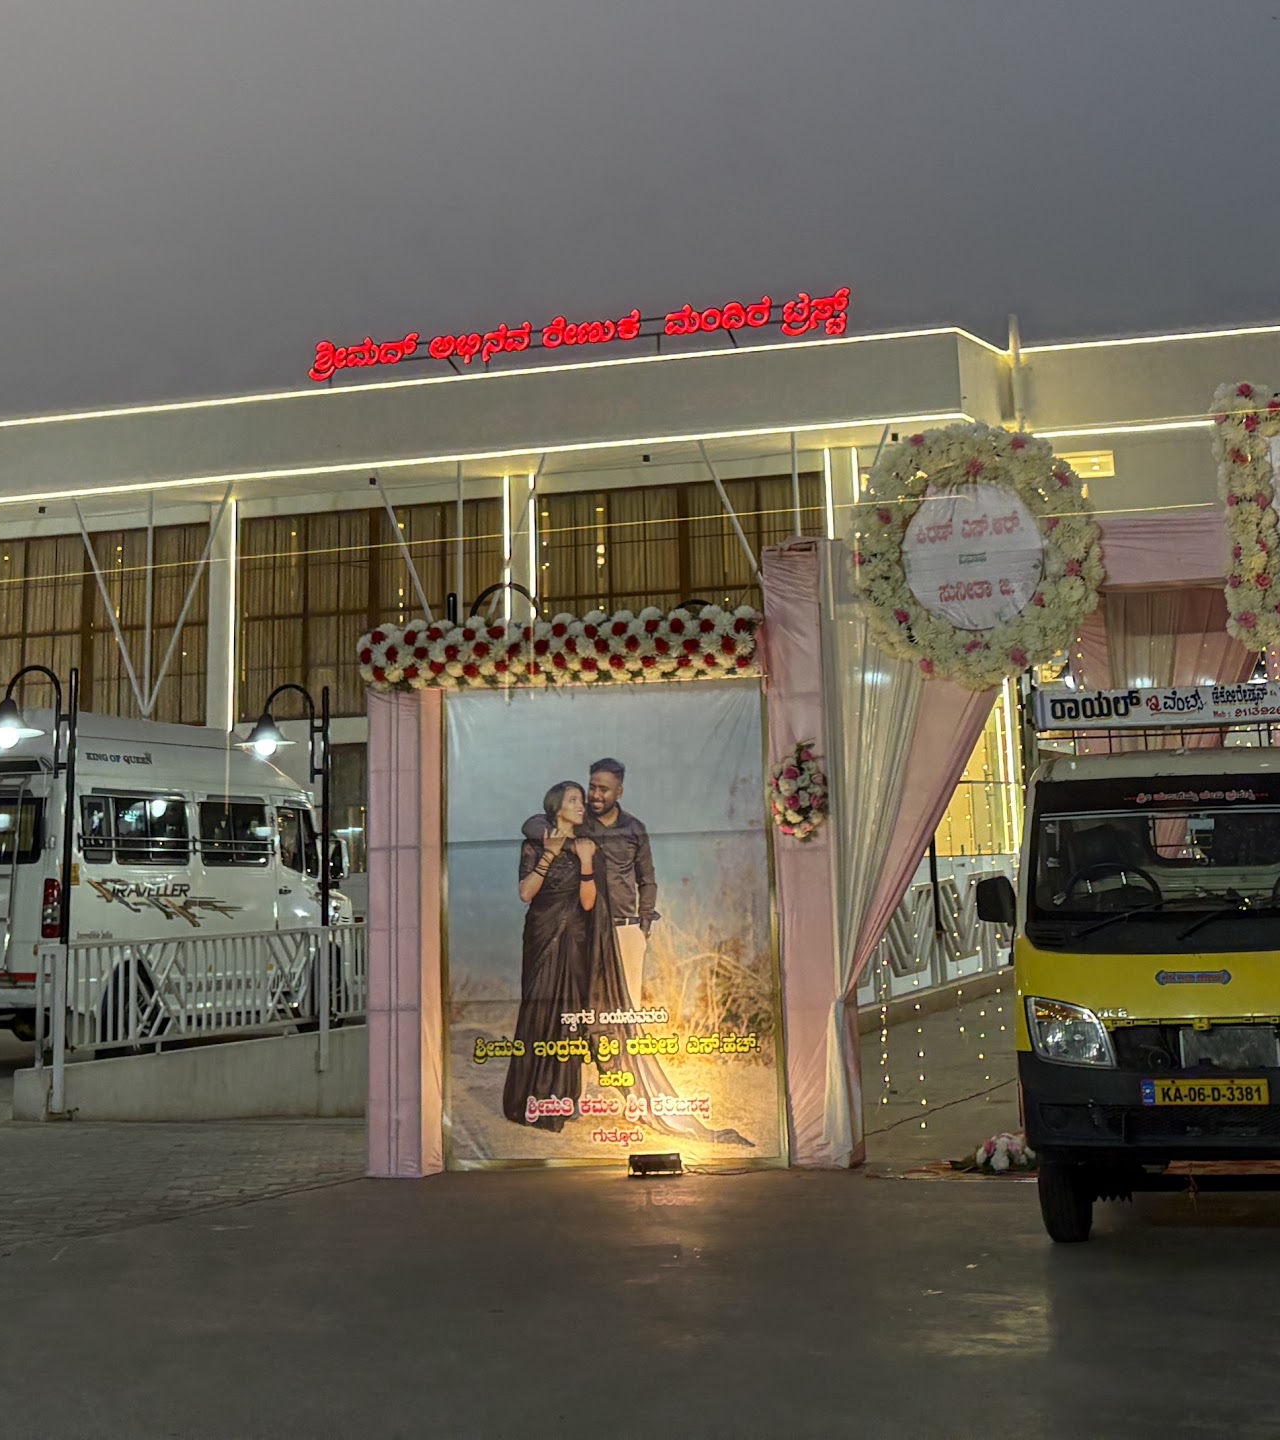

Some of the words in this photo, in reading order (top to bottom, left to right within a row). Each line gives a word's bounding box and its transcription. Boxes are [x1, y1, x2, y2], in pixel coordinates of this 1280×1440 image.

[308, 331, 419, 382] ಶ್ರೀಮದ್
[428, 321, 533, 365] ಅಭಿನವ
[542, 308, 642, 349] ರೇಣುಕ
[664, 295, 772, 336] ಮಂದಿರ
[781, 287, 851, 337] ಟ್ರಸ್ಟ್
[1050, 690, 1141, 720] ರಾಯಲ್
[560, 1009, 596, 1031] ಸ್ವಾಗತ
[599, 1007, 669, 1024] ಬಯಸುವವರು
[474, 1036, 526, 1064] ಶ್ರೀಮತಿ
[532, 1036, 592, 1064] ಇಂದ್ರಮ್ಮ
[597, 1034, 620, 1062] ಶ್ರೀ
[626, 1033, 680, 1055] ರಮೇಶ
[1161, 1086, 1262, 1102] KA-06-D-3381
[526, 1096, 574, 1122] ಶ್ರೀಮತಿ
[579, 1096, 621, 1115] ಕಮಲ
[625, 1096, 647, 1122] ಶ್ರೀ
[592, 1127, 644, 1147] ಗುತ್ತೂರು
